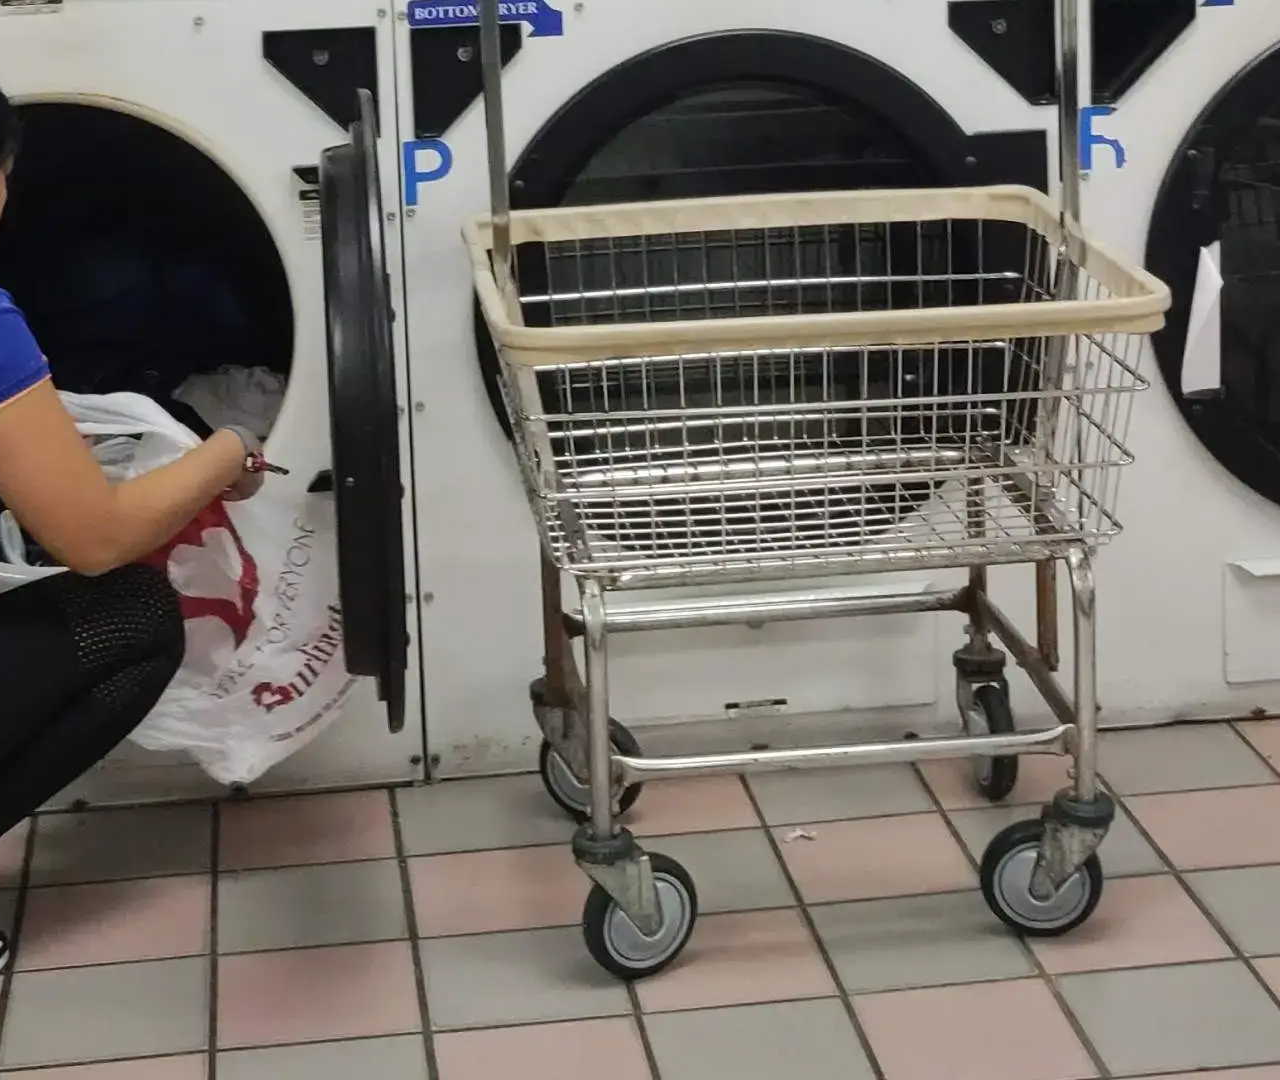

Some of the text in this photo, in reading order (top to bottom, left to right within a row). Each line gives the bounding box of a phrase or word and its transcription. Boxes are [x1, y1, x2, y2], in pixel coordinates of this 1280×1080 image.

[498, 2, 538, 16] RYER
[403, 139, 453, 206] P
[251, 603, 342, 714] Burlingt
